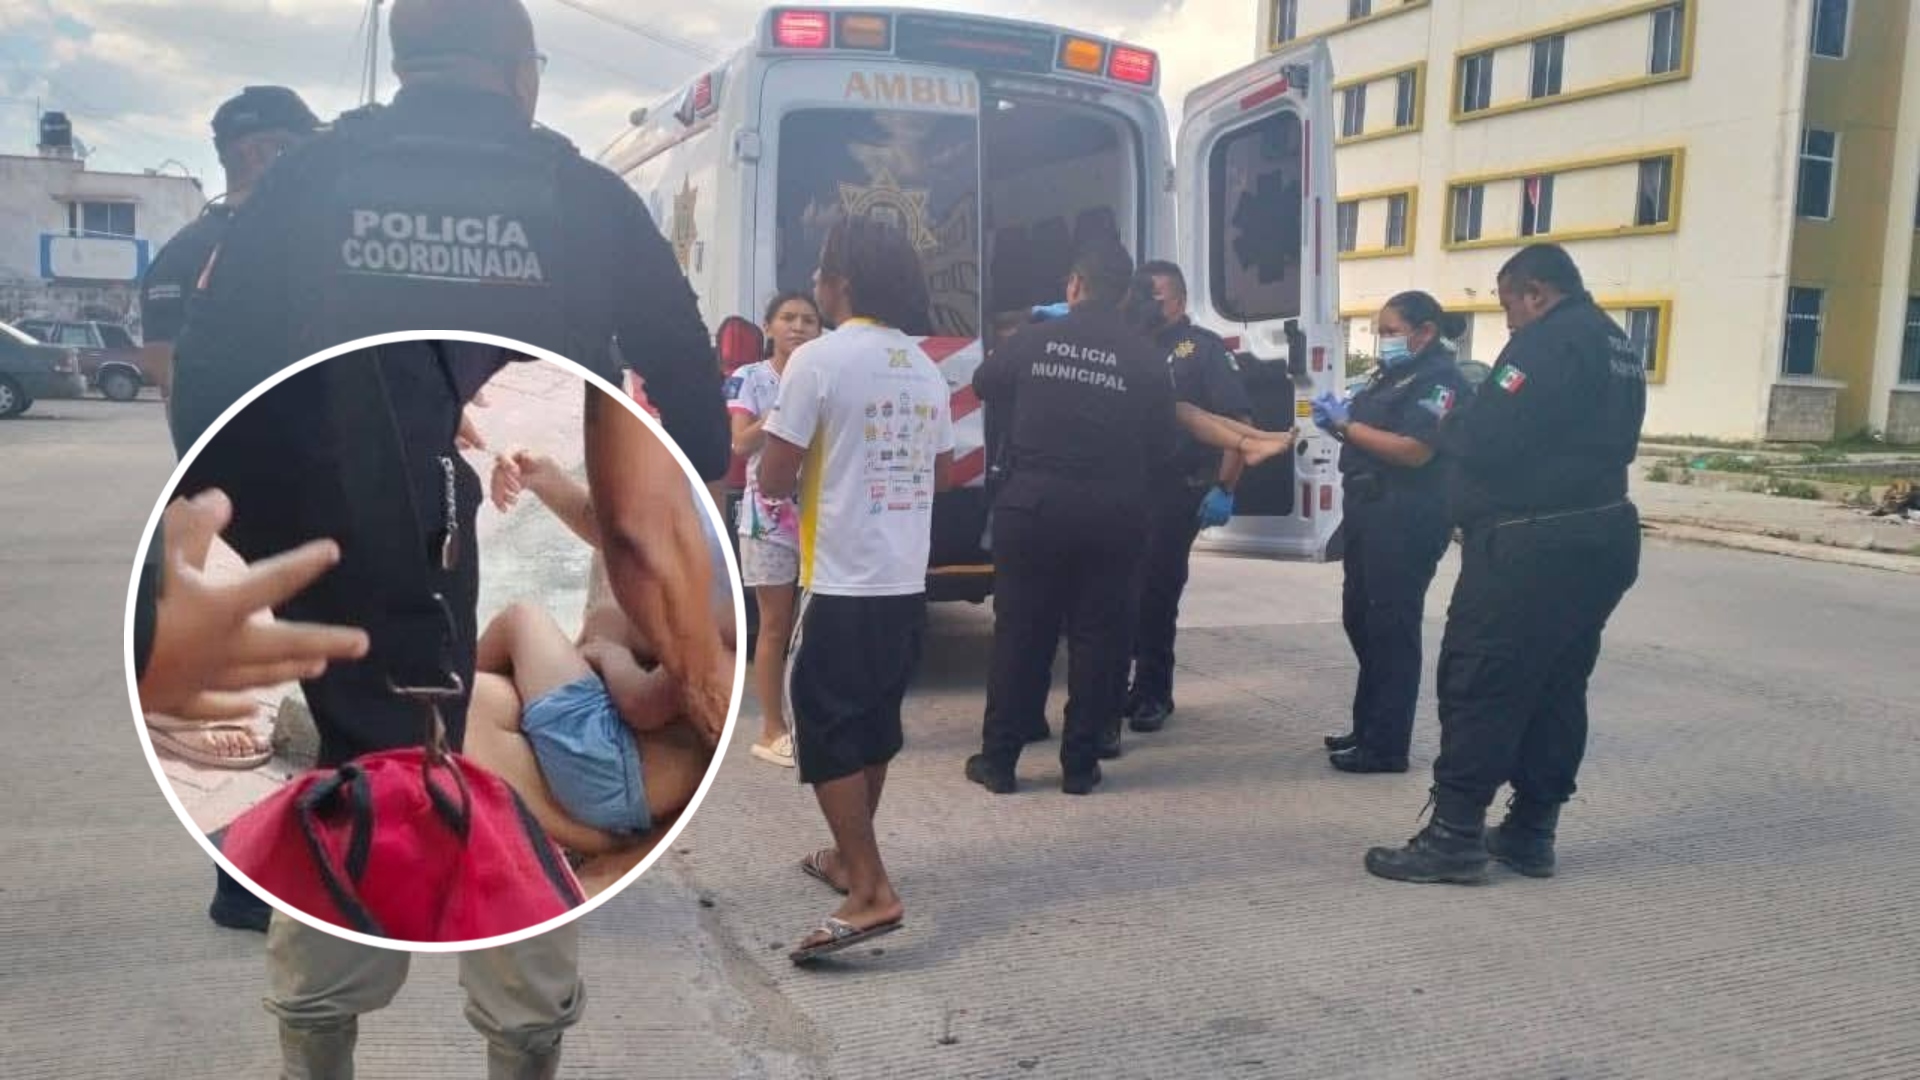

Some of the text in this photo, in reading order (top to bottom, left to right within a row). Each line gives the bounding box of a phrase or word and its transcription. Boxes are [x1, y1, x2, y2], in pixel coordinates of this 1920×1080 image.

[352, 209, 529, 248] POLICÍA
[342, 238, 543, 280] COORDINADA
[1045, 341, 1117, 367] POLICIA
[1031, 361, 1128, 391] MUNICIPAL
